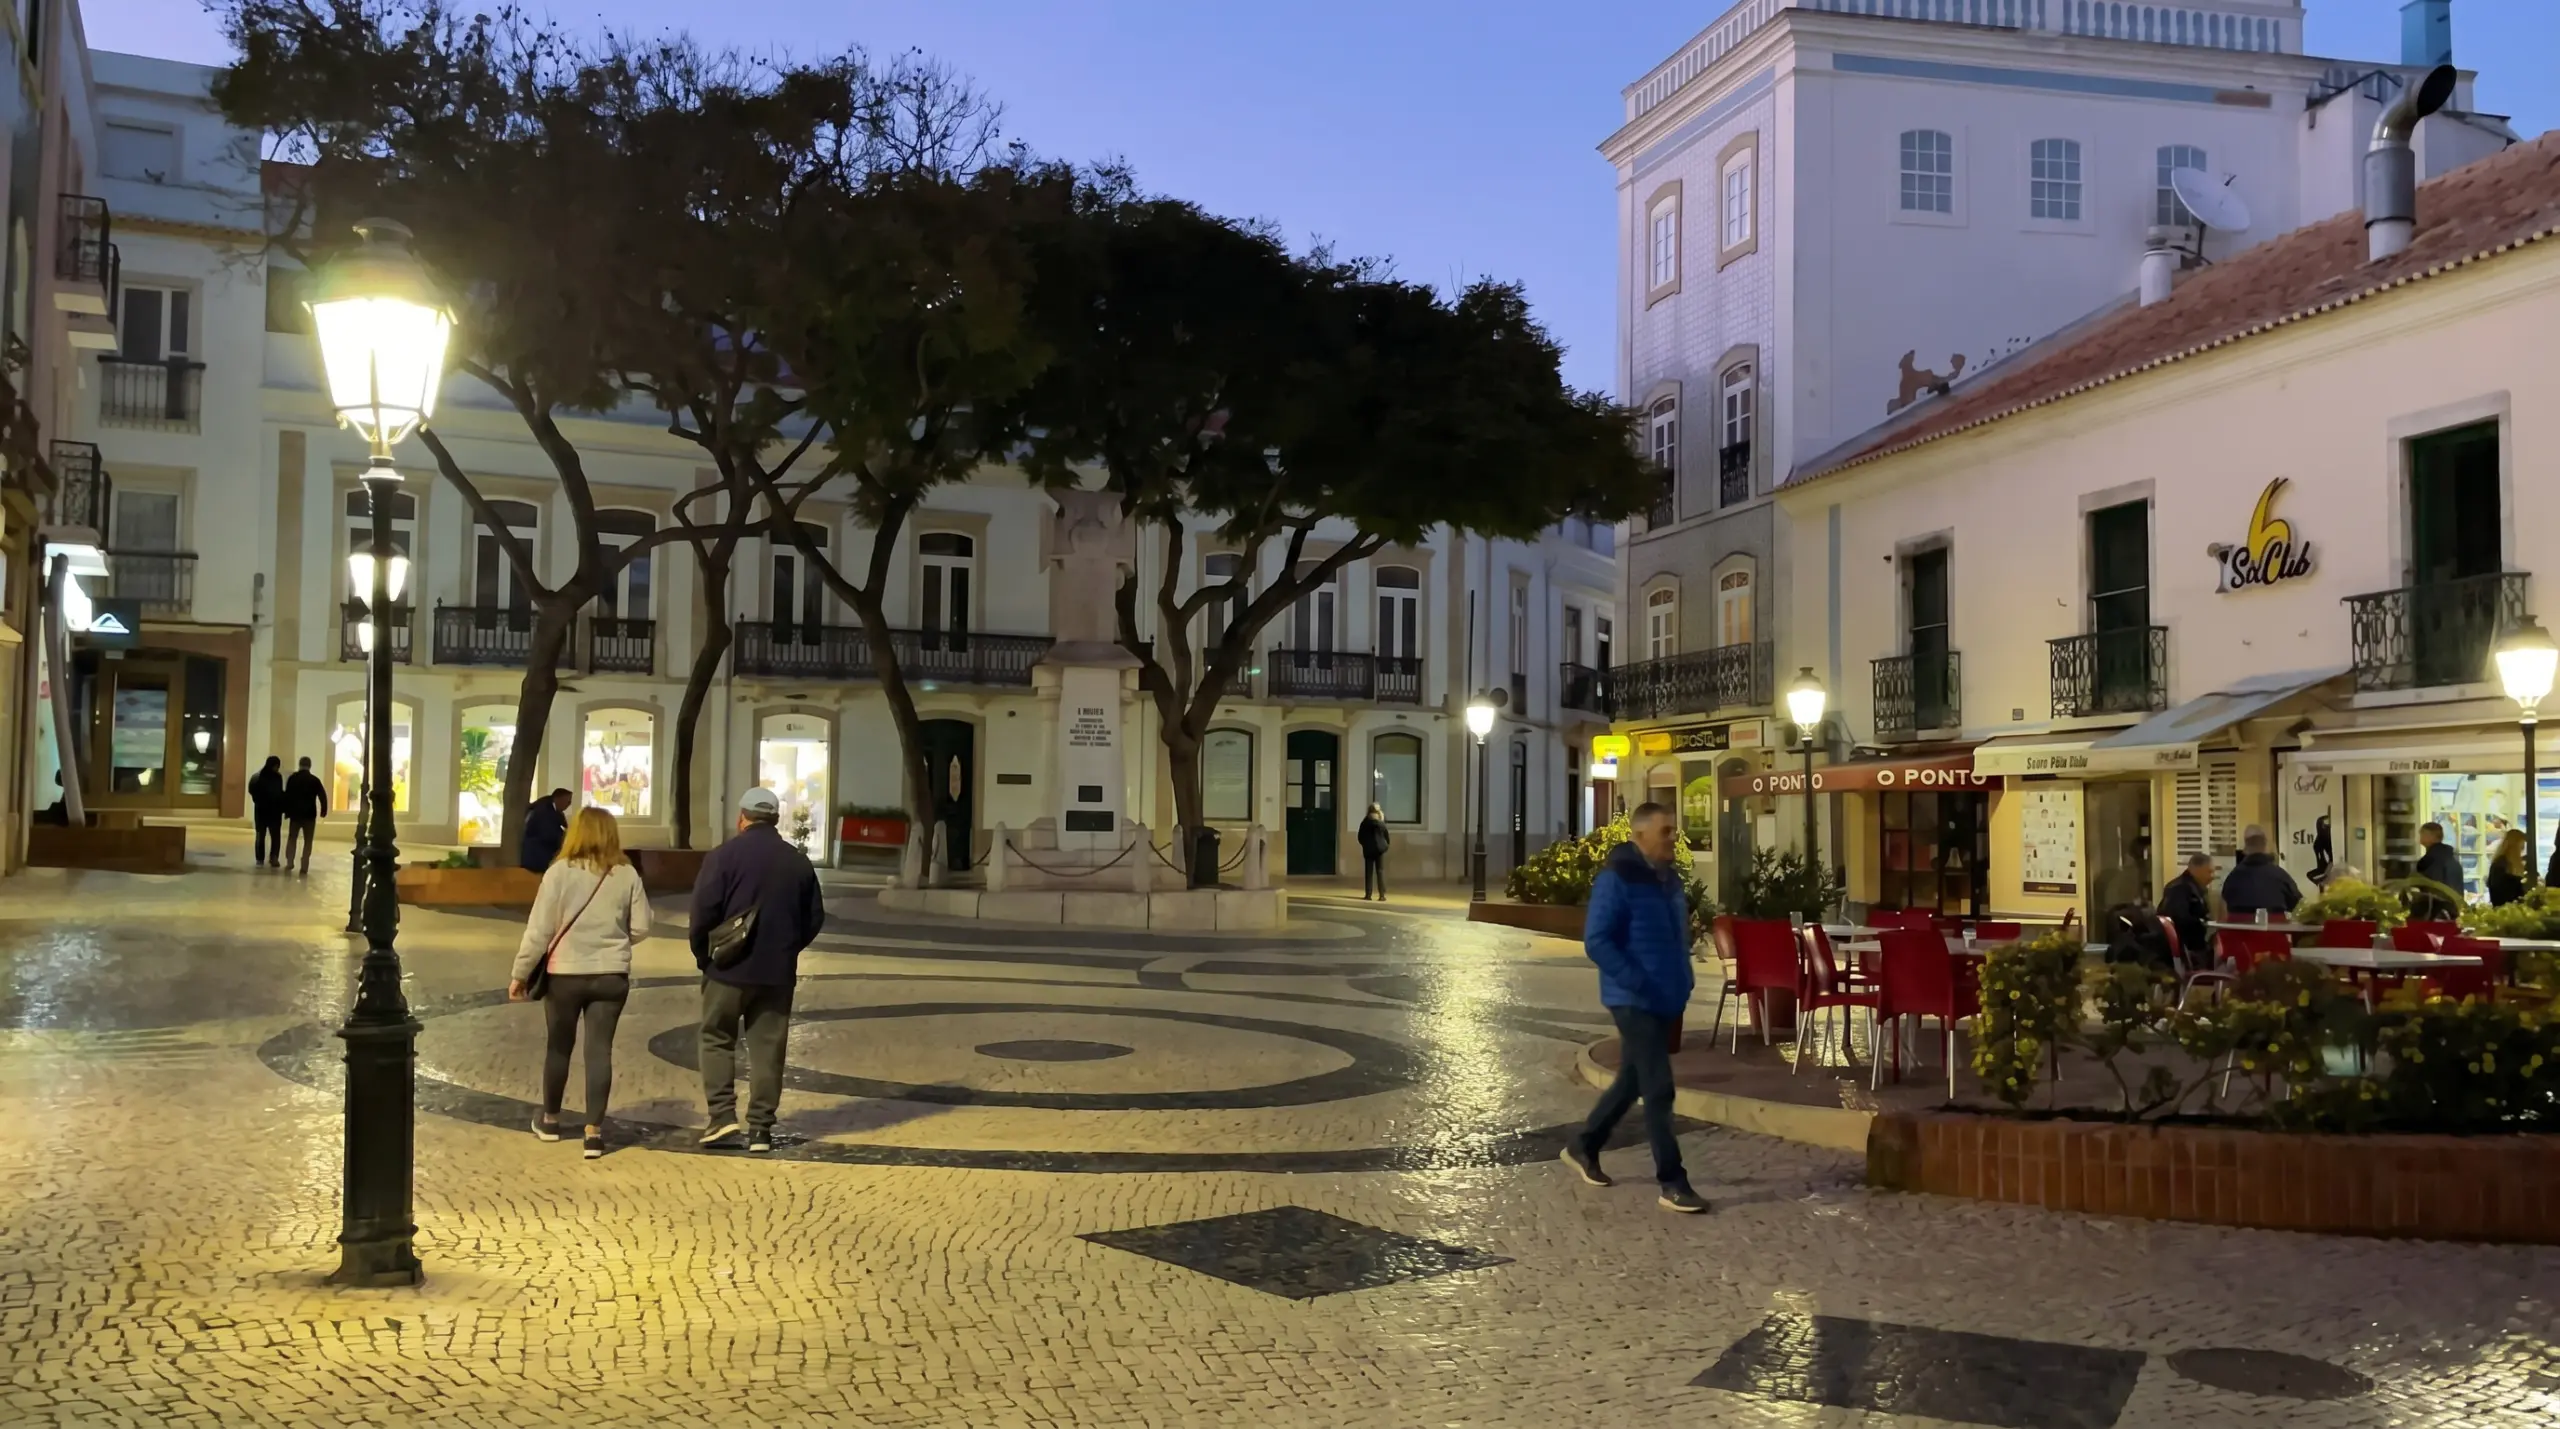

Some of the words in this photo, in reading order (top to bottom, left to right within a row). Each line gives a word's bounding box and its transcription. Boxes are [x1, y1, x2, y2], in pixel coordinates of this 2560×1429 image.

[1753, 778, 1763, 792] O
[1769, 773, 1823, 791] PONTO
[1877, 770, 1895, 785] O
[1904, 769, 1987, 785] PONTO
